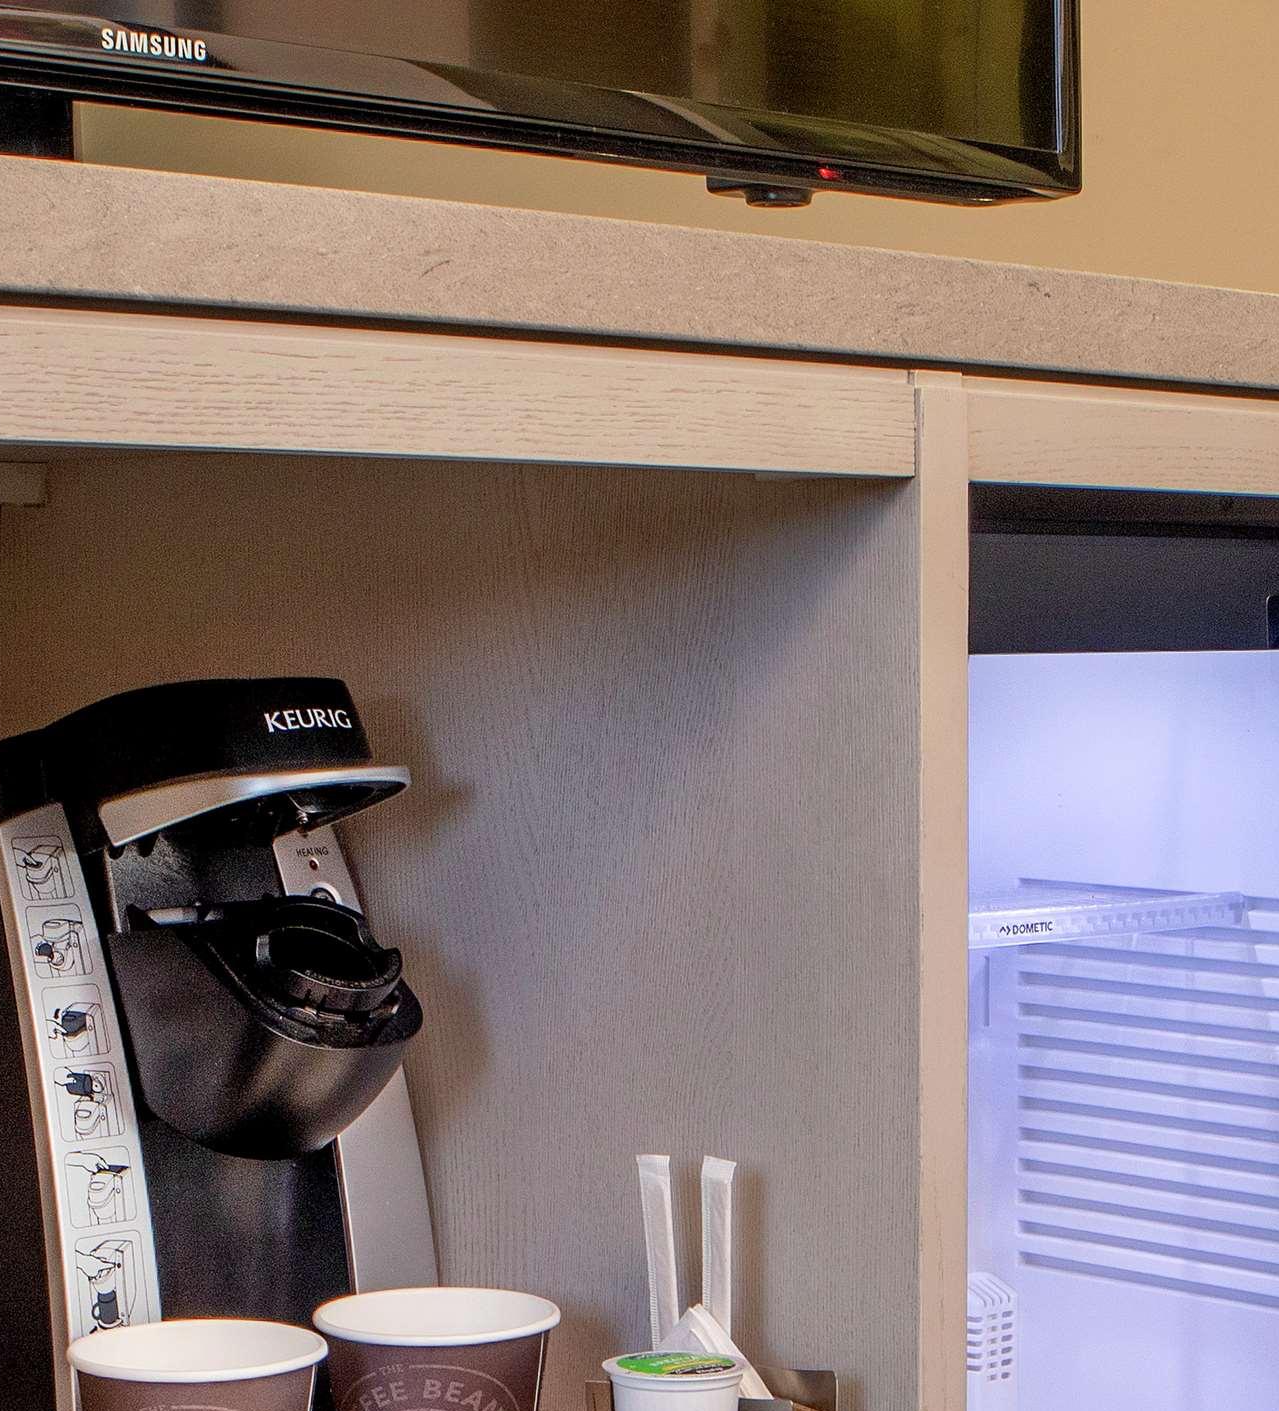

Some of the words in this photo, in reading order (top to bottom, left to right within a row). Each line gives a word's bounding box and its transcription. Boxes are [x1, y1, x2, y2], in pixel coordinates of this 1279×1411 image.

[101, 28, 207, 61] SAMSUNG
[264, 709, 353, 733] KEURIG
[295, 846, 329, 858] HEATING
[1012, 920, 1053, 935] DOMETIC
[380, 1364, 404, 1376] THE
